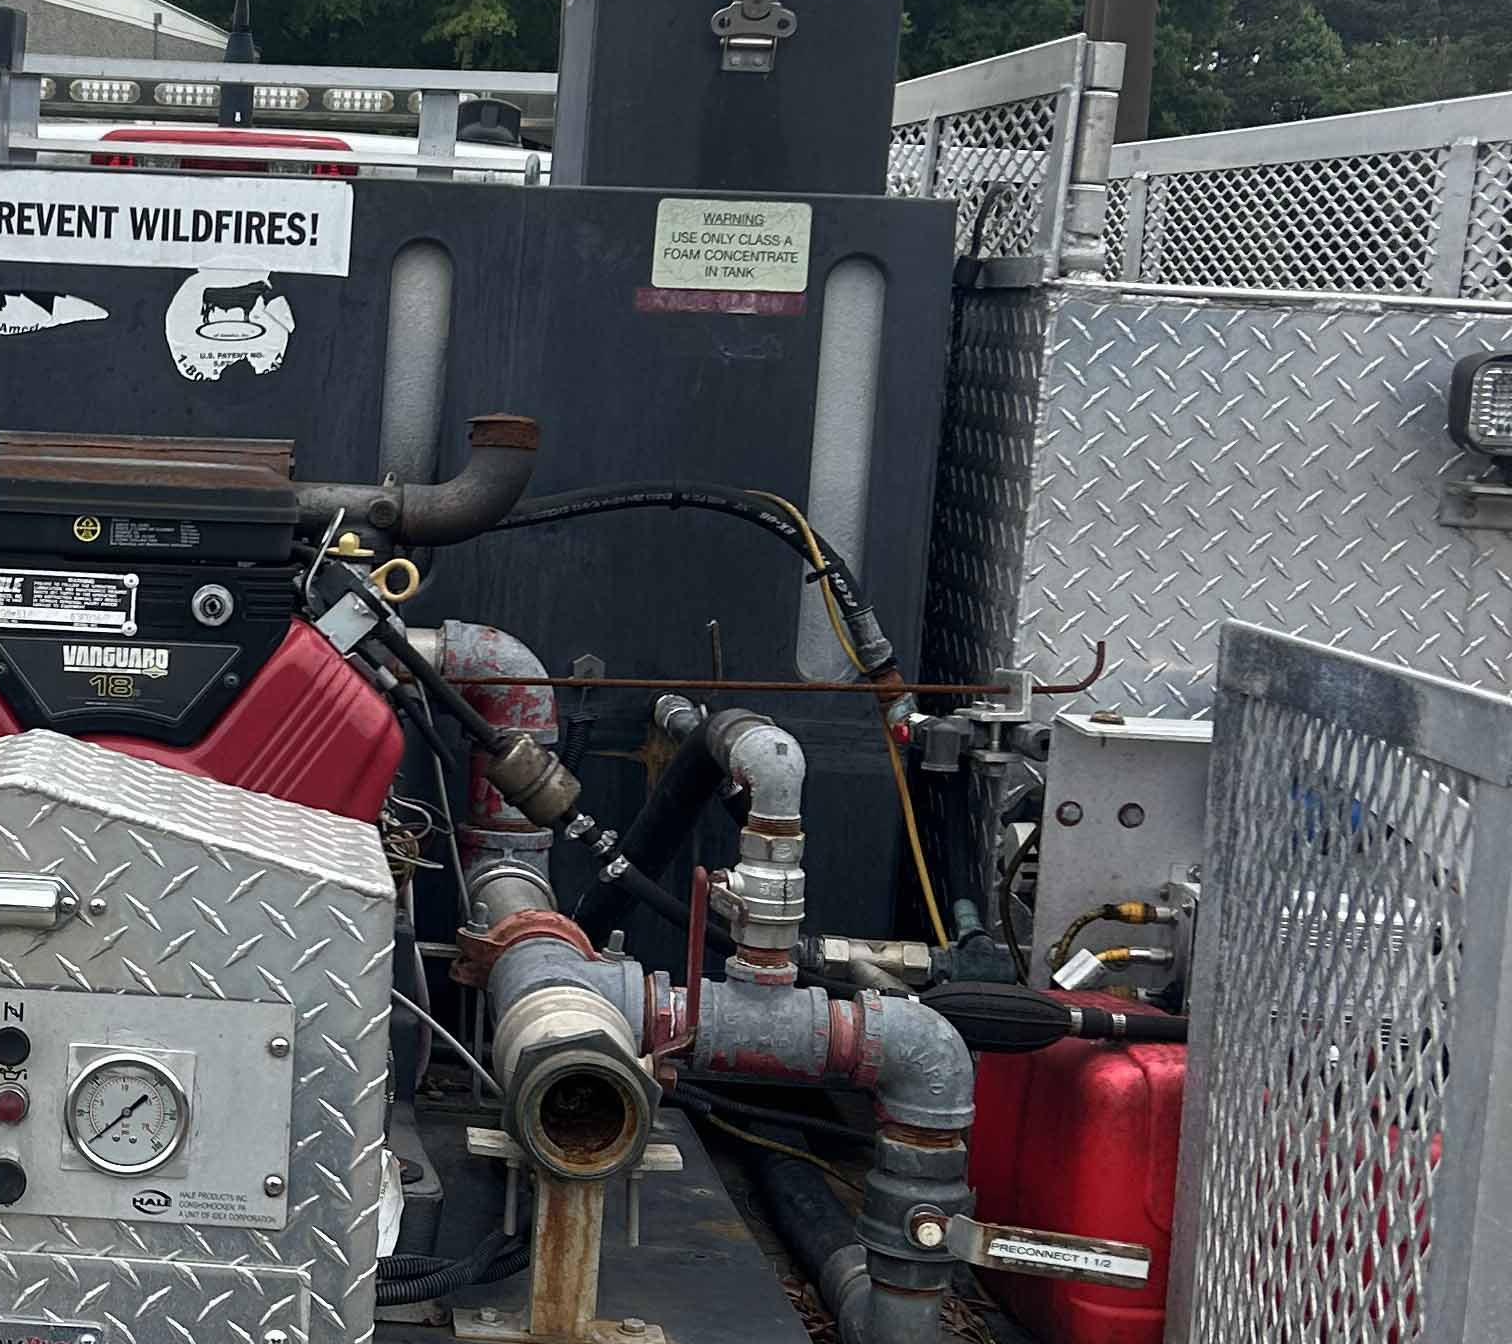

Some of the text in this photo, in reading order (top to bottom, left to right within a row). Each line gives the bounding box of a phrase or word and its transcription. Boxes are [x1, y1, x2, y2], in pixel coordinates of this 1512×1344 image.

[129, 206, 320, 247] WILDFIRES!
[703, 213, 765, 226] WARNING
[671, 232, 793, 246] USE ONLY CLASS A
[663, 248, 800, 263] FOAM CONCENTRATE
[705, 266, 756, 278] IN TANK
[62, 645, 169, 669] VANGUARD
[89, 674, 134, 697] 18
[133, 1197, 172, 1207] HALE
[991, 1243, 1080, 1263] PRECONNECT
[1095, 1258, 1112, 1268] 1/2
